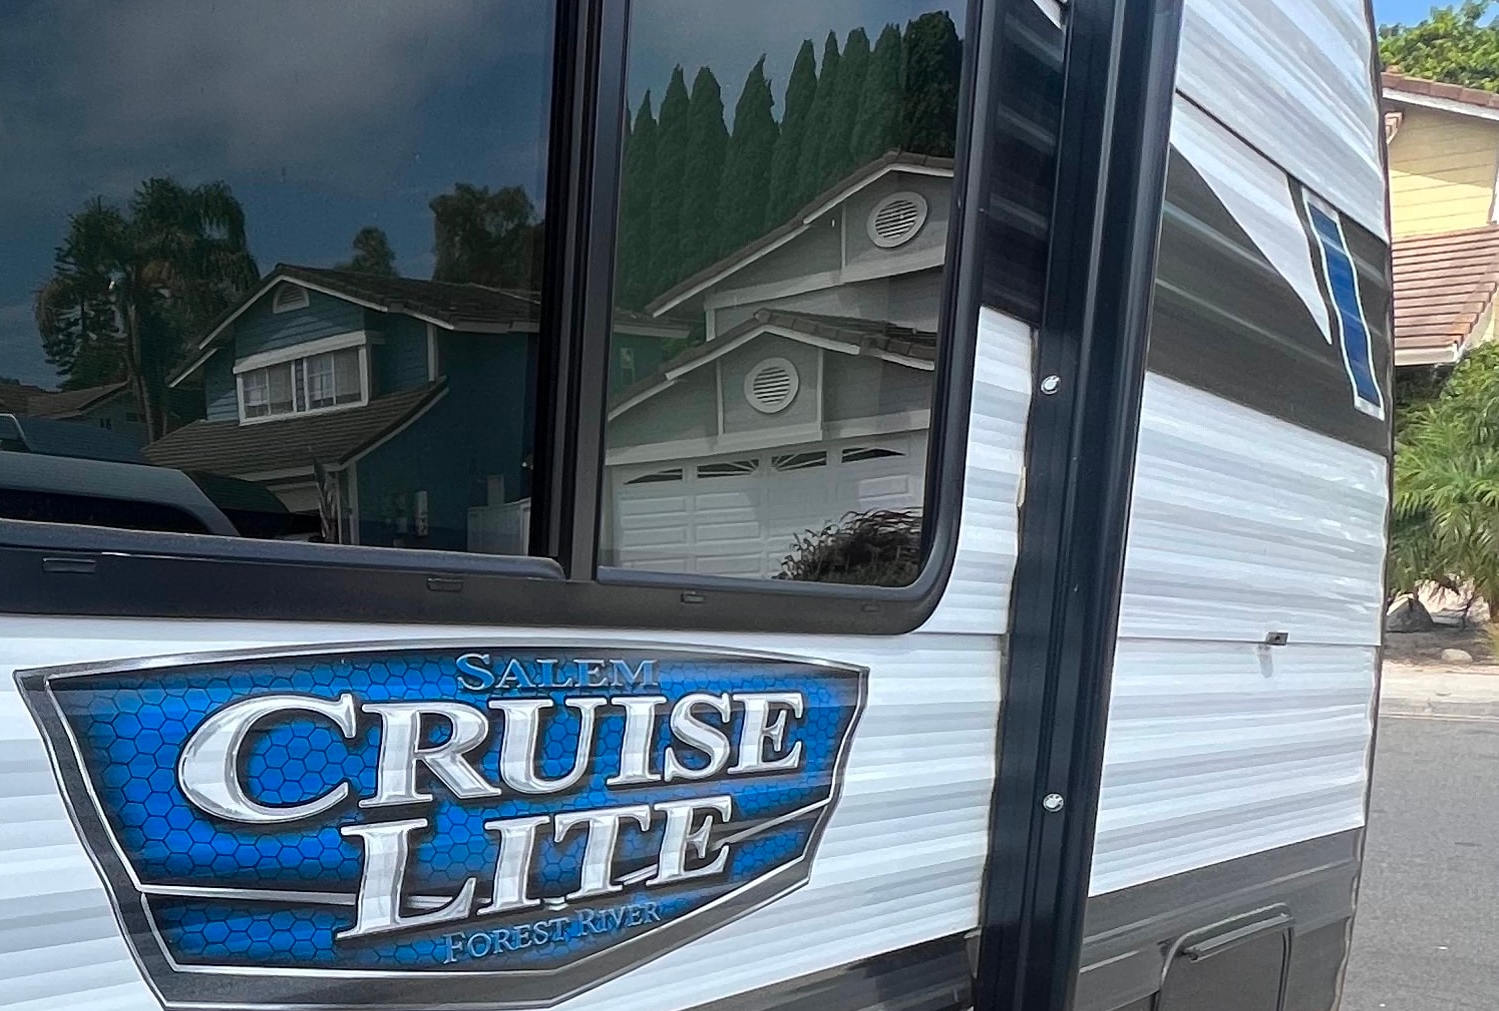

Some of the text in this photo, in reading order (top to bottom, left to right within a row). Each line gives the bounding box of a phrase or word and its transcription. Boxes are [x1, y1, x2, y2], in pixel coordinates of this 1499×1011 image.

[456, 653, 658, 691] SALEM
[177, 691, 805, 825] CRUISE
[335, 796, 734, 940] LITE
[443, 901, 661, 964] FOREST RIVER
